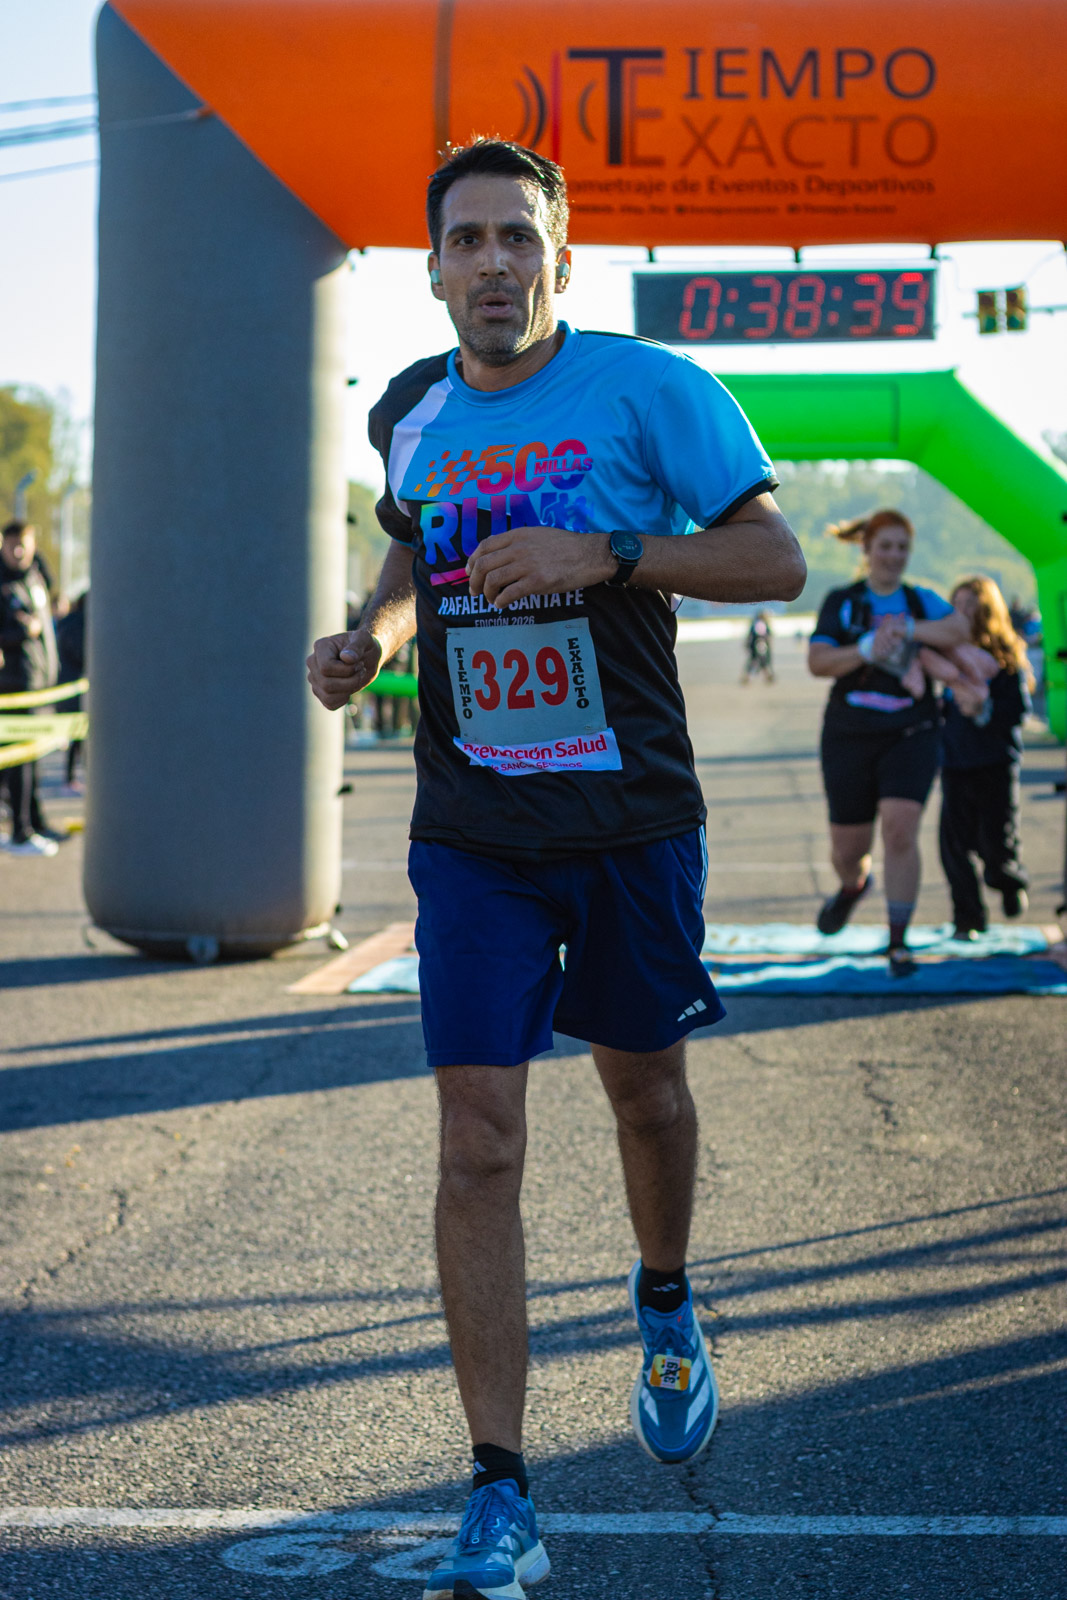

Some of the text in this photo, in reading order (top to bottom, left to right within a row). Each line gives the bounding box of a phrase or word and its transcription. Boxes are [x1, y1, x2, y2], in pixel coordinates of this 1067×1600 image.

[672, 176, 701, 194] de
[707, 175, 799, 194] Eventos
[804, 174, 936, 197] Deportivos
[679, 272, 929, 340] 0:38:39
[534, 458, 594, 475] MILLAS
[509, 592, 562, 611] SANTA
[566, 587, 585, 607] FE
[474, 616, 535, 628] EDICIÓN 2026
[453, 647, 473, 720] TIEMPO
[472, 646, 569, 711] 329
[567, 637, 590, 709] EXACTO
[463, 734, 608, 760] Prevnción Salud
